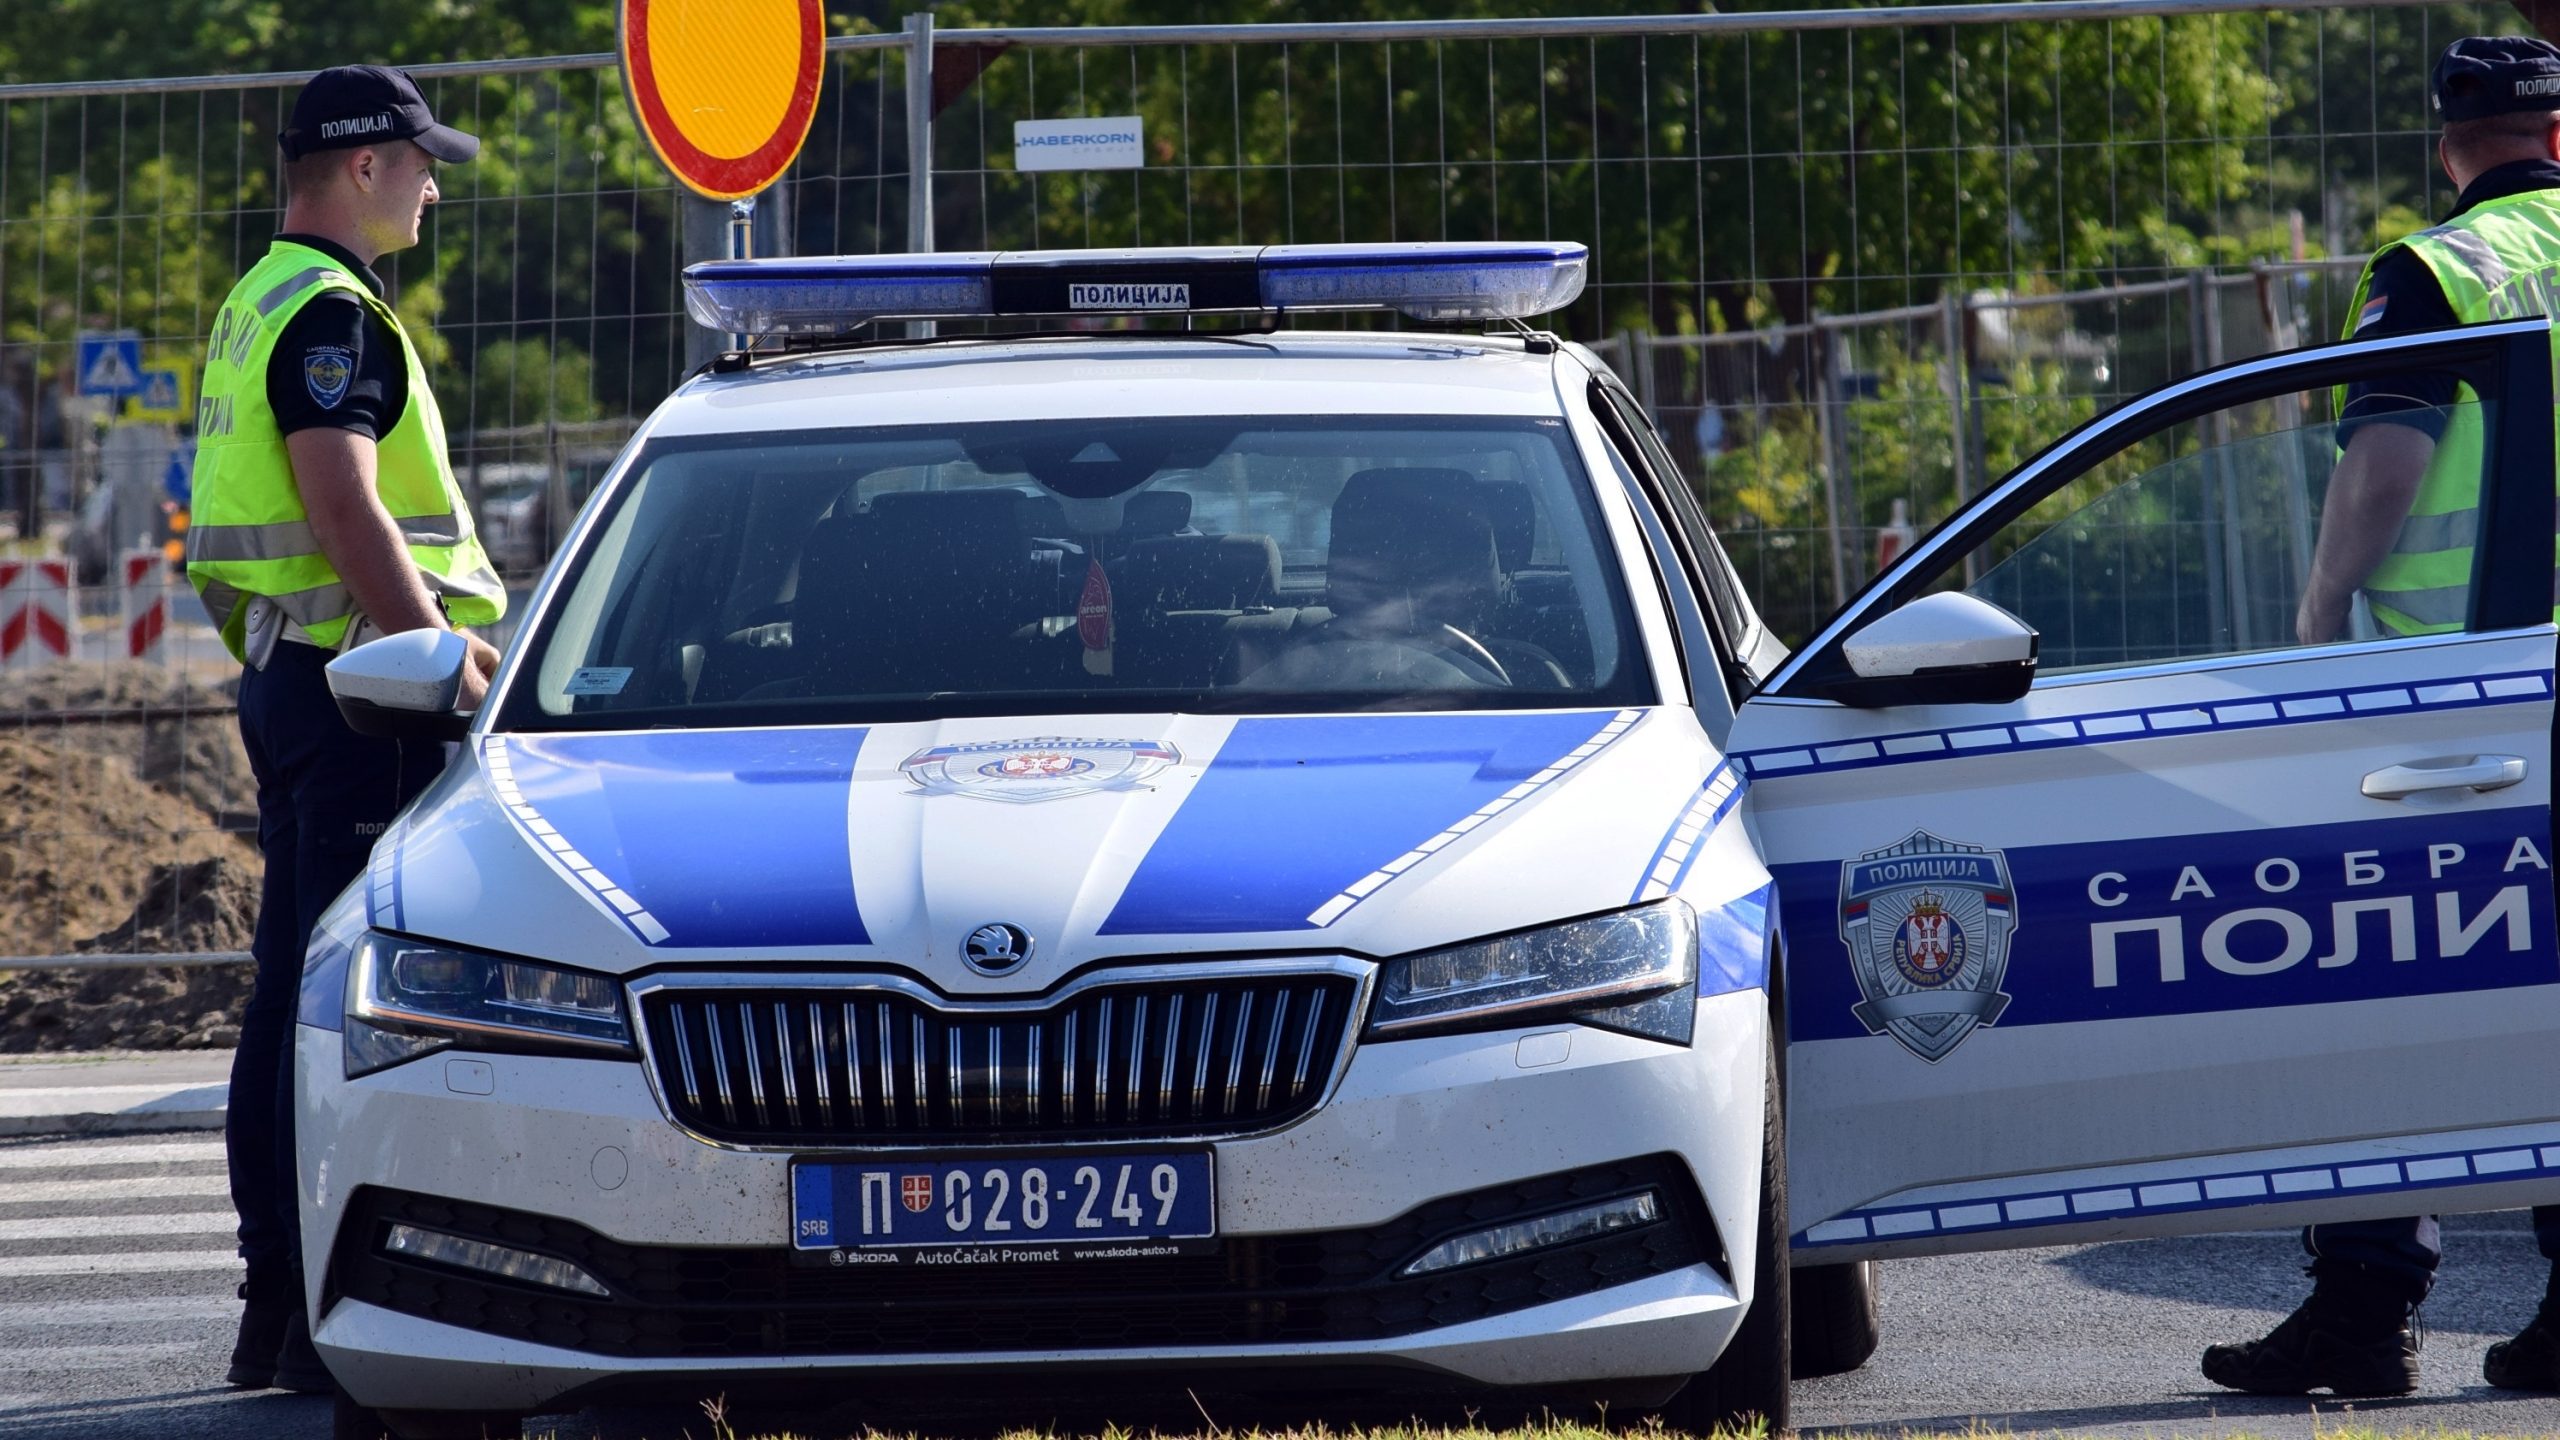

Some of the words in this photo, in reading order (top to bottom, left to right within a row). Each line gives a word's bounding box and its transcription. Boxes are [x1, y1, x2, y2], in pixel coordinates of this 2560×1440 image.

[321, 114, 390, 139] ПОЛИЦИЈА
[1021, 133, 1136, 147] HABERKORN
[1072, 286, 1187, 306] ПОЛИЦИЈА
[958, 742, 1132, 752] ПОЛИЦИЈА
[1869, 861, 1979, 884] ПОЛИЦИЈА
[2088, 836, 2549, 906] САОБРА
[2090, 885, 2532, 988] ПОЛИ
[1896, 939, 1942, 984] РЕПУБЛИКА
[1943, 933, 1963, 977] СРБИЈА
[801, 1220, 829, 1236] SRB
[848, 1251, 899, 1264] ŠKODA
[915, 1248, 999, 1265] AutoČačak
[1002, 1249, 1060, 1263] Promet
[1074, 1245, 1179, 1259] www.skoda-auto.rs
